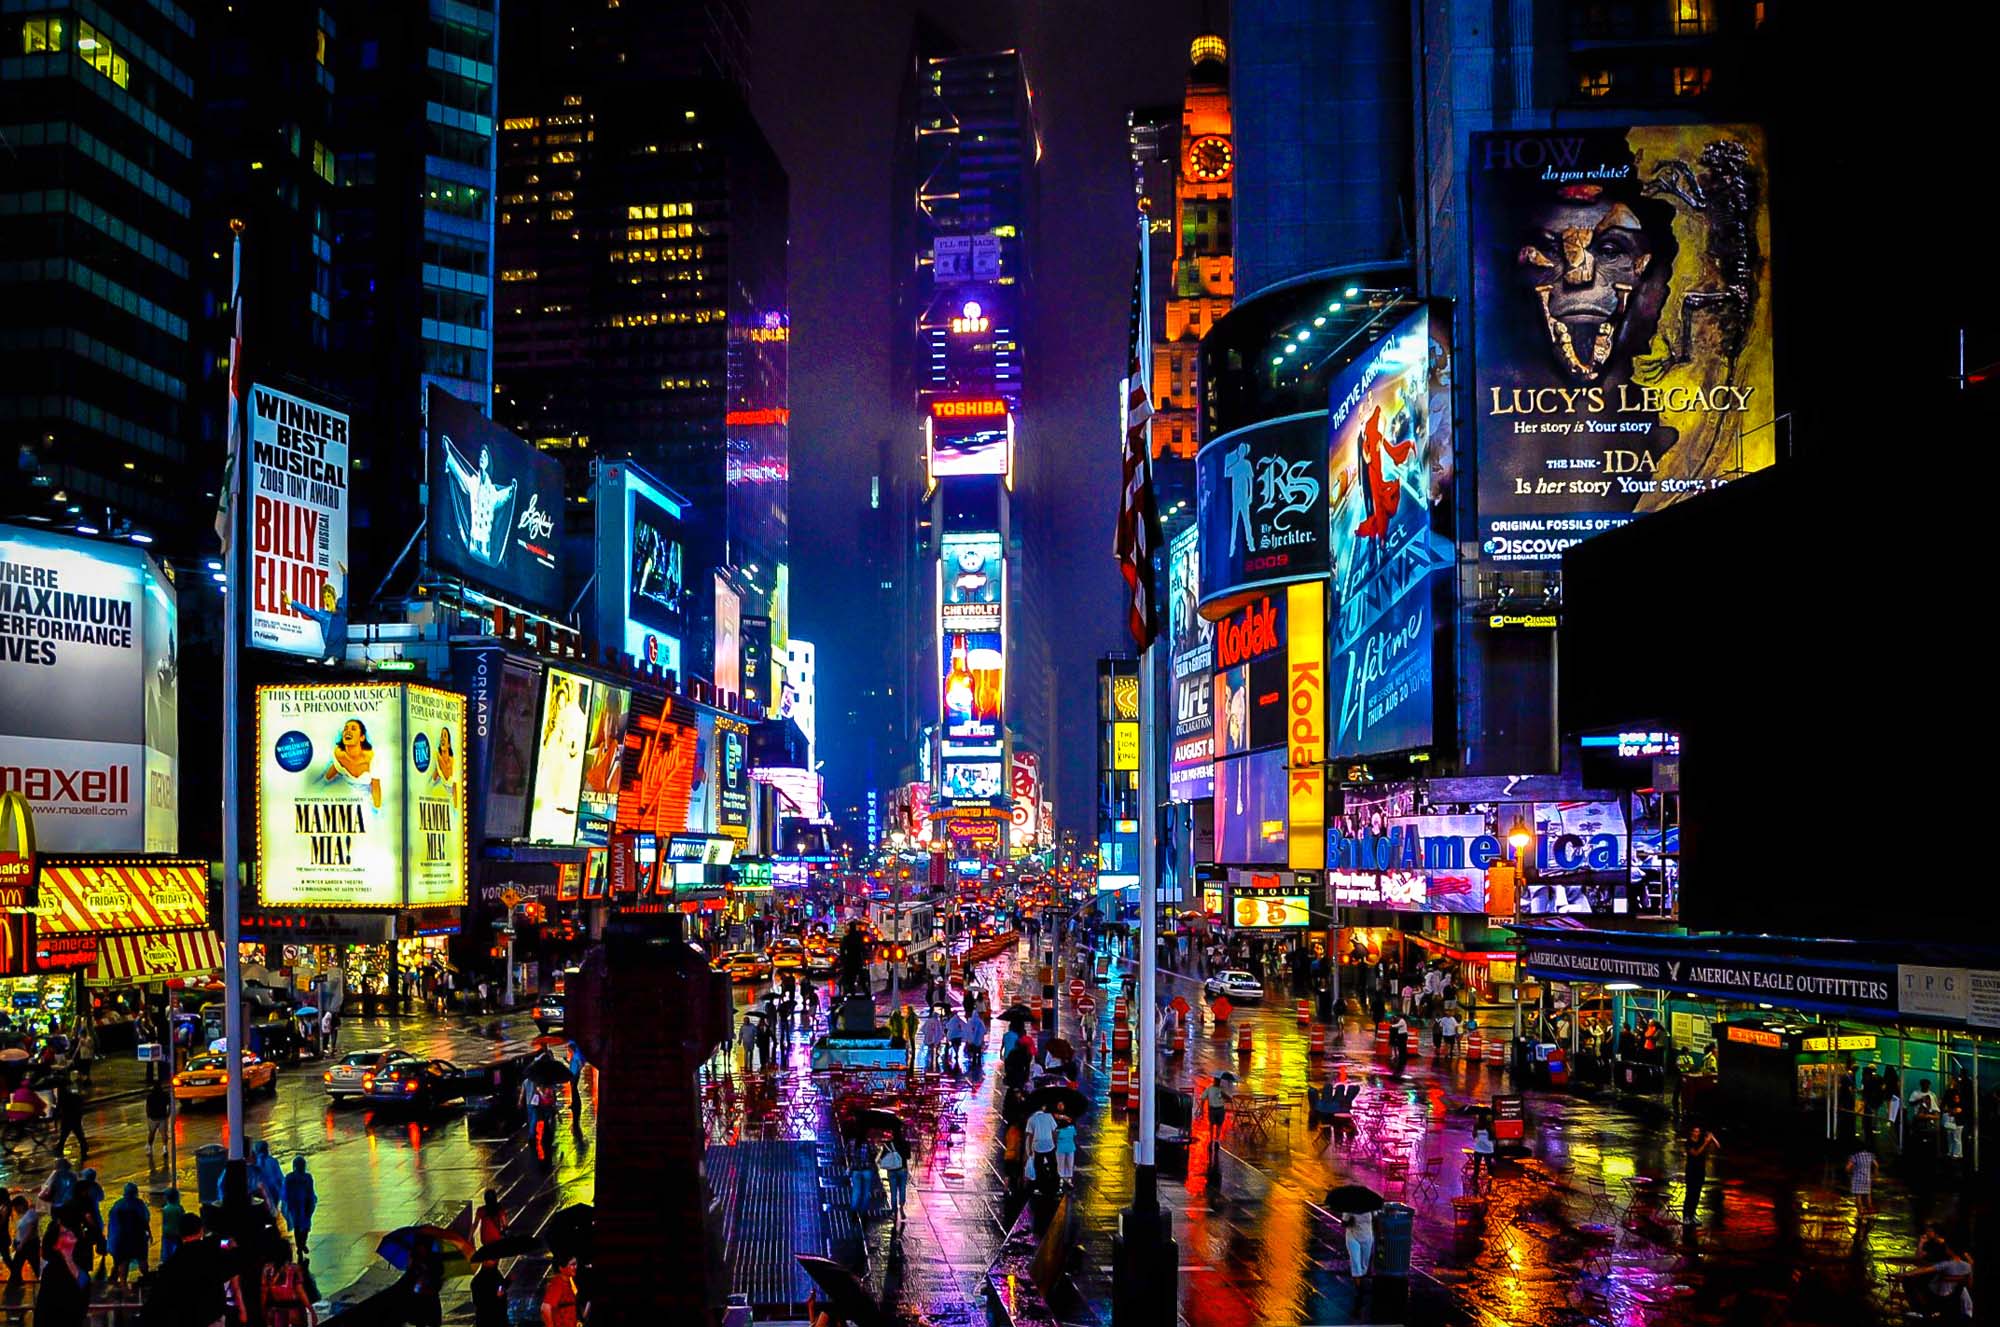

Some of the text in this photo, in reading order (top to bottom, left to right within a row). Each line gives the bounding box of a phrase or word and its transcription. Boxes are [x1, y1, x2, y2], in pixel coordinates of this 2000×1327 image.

[1541, 164, 1630, 182] do you relate?
[933, 401, 1005, 416] TOSHIBA
[1490, 385, 1754, 415] LUCY'S LEGACY
[255, 388, 347, 445] WINNER
[1514, 420, 1652, 434] Her story is Your story
[278, 423, 327, 461] BEST
[254, 439, 346, 489] MUSICAL
[1546, 460, 1567, 468] THE
[1602, 450, 1657, 473] IDA
[260, 466, 339, 510] 2009 TONY AWARD
[1515, 478, 1531, 494] Is
[1535, 476, 1567, 494] her
[1569, 479, 1611, 496] story
[1617, 476, 1657, 493] Your
[255, 495, 318, 564] BILLY
[1491, 521, 1545, 531] ORIGINAL
[1547, 519, 1593, 530] FOSSILS
[1595, 519, 1610, 529] OF
[319, 513, 329, 567] THE MUSICAL
[255, 555, 329, 621] ELLIOT
[944, 604, 999, 615] CHEVROLET
[0, 613, 131, 648] ERFORMANCE
[1218, 597, 1277, 667] Kodak
[0, 636, 56, 666] IVES
[1337, 605, 1422, 749] Lifetime
[281, 703, 290, 712] IS
[294, 703, 300, 712] A
[294, 689, 350, 701] FEEL-GOOD
[354, 688, 398, 700] MUSICAL
[477, 652, 487, 736] VORNADO
[1178, 674, 1209, 720] UFC
[1385, 691, 1399, 714] AUG
[1176, 716, 1212, 736] DECLARATION
[1293, 661, 1319, 796] Kodak
[1175, 739, 1208, 762] AUGUST
[0, 766, 129, 803] maxell
[295, 804, 366, 833] MAMMA
[420, 802, 451, 831] MAMMA
[949, 825, 995, 836] YAHOO!
[311, 835, 351, 865] MIA!
[670, 842, 705, 858] VORNADO
[1401, 824, 1620, 871] Ameica
[90, 894, 125, 906] FRIDAY'S
[156, 893, 187, 905] FRIDAY'S
[1234, 887, 1310, 895] MARQUIS
[1529, 953, 1660, 978] AMERICAN EAGLE OUTFITTERS
[1689, 966, 1889, 1001] AMERICAN EAGLE OUTFITTERS
